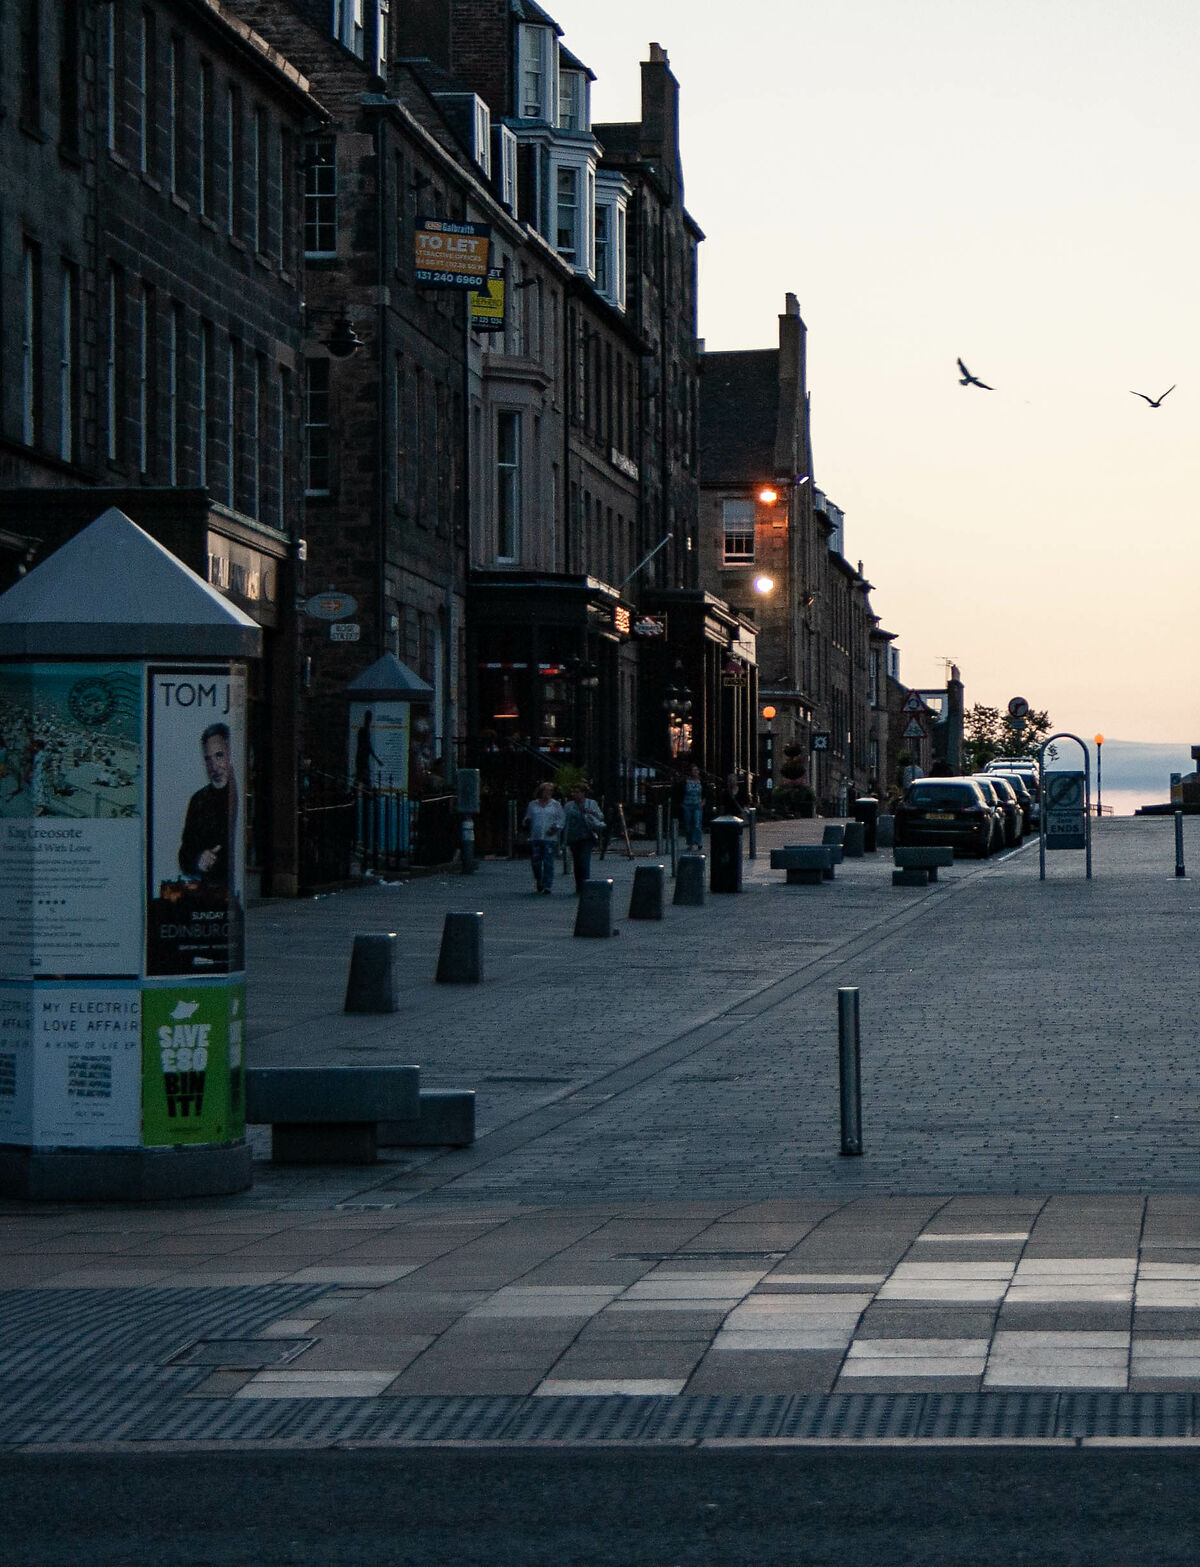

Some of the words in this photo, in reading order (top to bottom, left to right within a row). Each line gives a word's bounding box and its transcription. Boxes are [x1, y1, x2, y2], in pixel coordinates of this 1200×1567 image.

[418, 234, 443, 249] TO
[446, 237, 480, 253] LET
[416, 270, 432, 281] 131
[433, 272, 454, 283] 240
[456, 275, 483, 286] 6960
[160, 683, 217, 707] TOM
[1051, 825, 1079, 833] ENDS
[191, 911, 224, 920] SUNDAY
[42, 1002, 60, 1012] MY
[70, 1002, 139, 1014] ELECTRIC
[43, 1020, 77, 1031] LOVE
[88, 1021, 138, 1031] AFFAIR
[159, 1023, 212, 1048] SAVE
[165, 1072, 206, 1095] BIN
